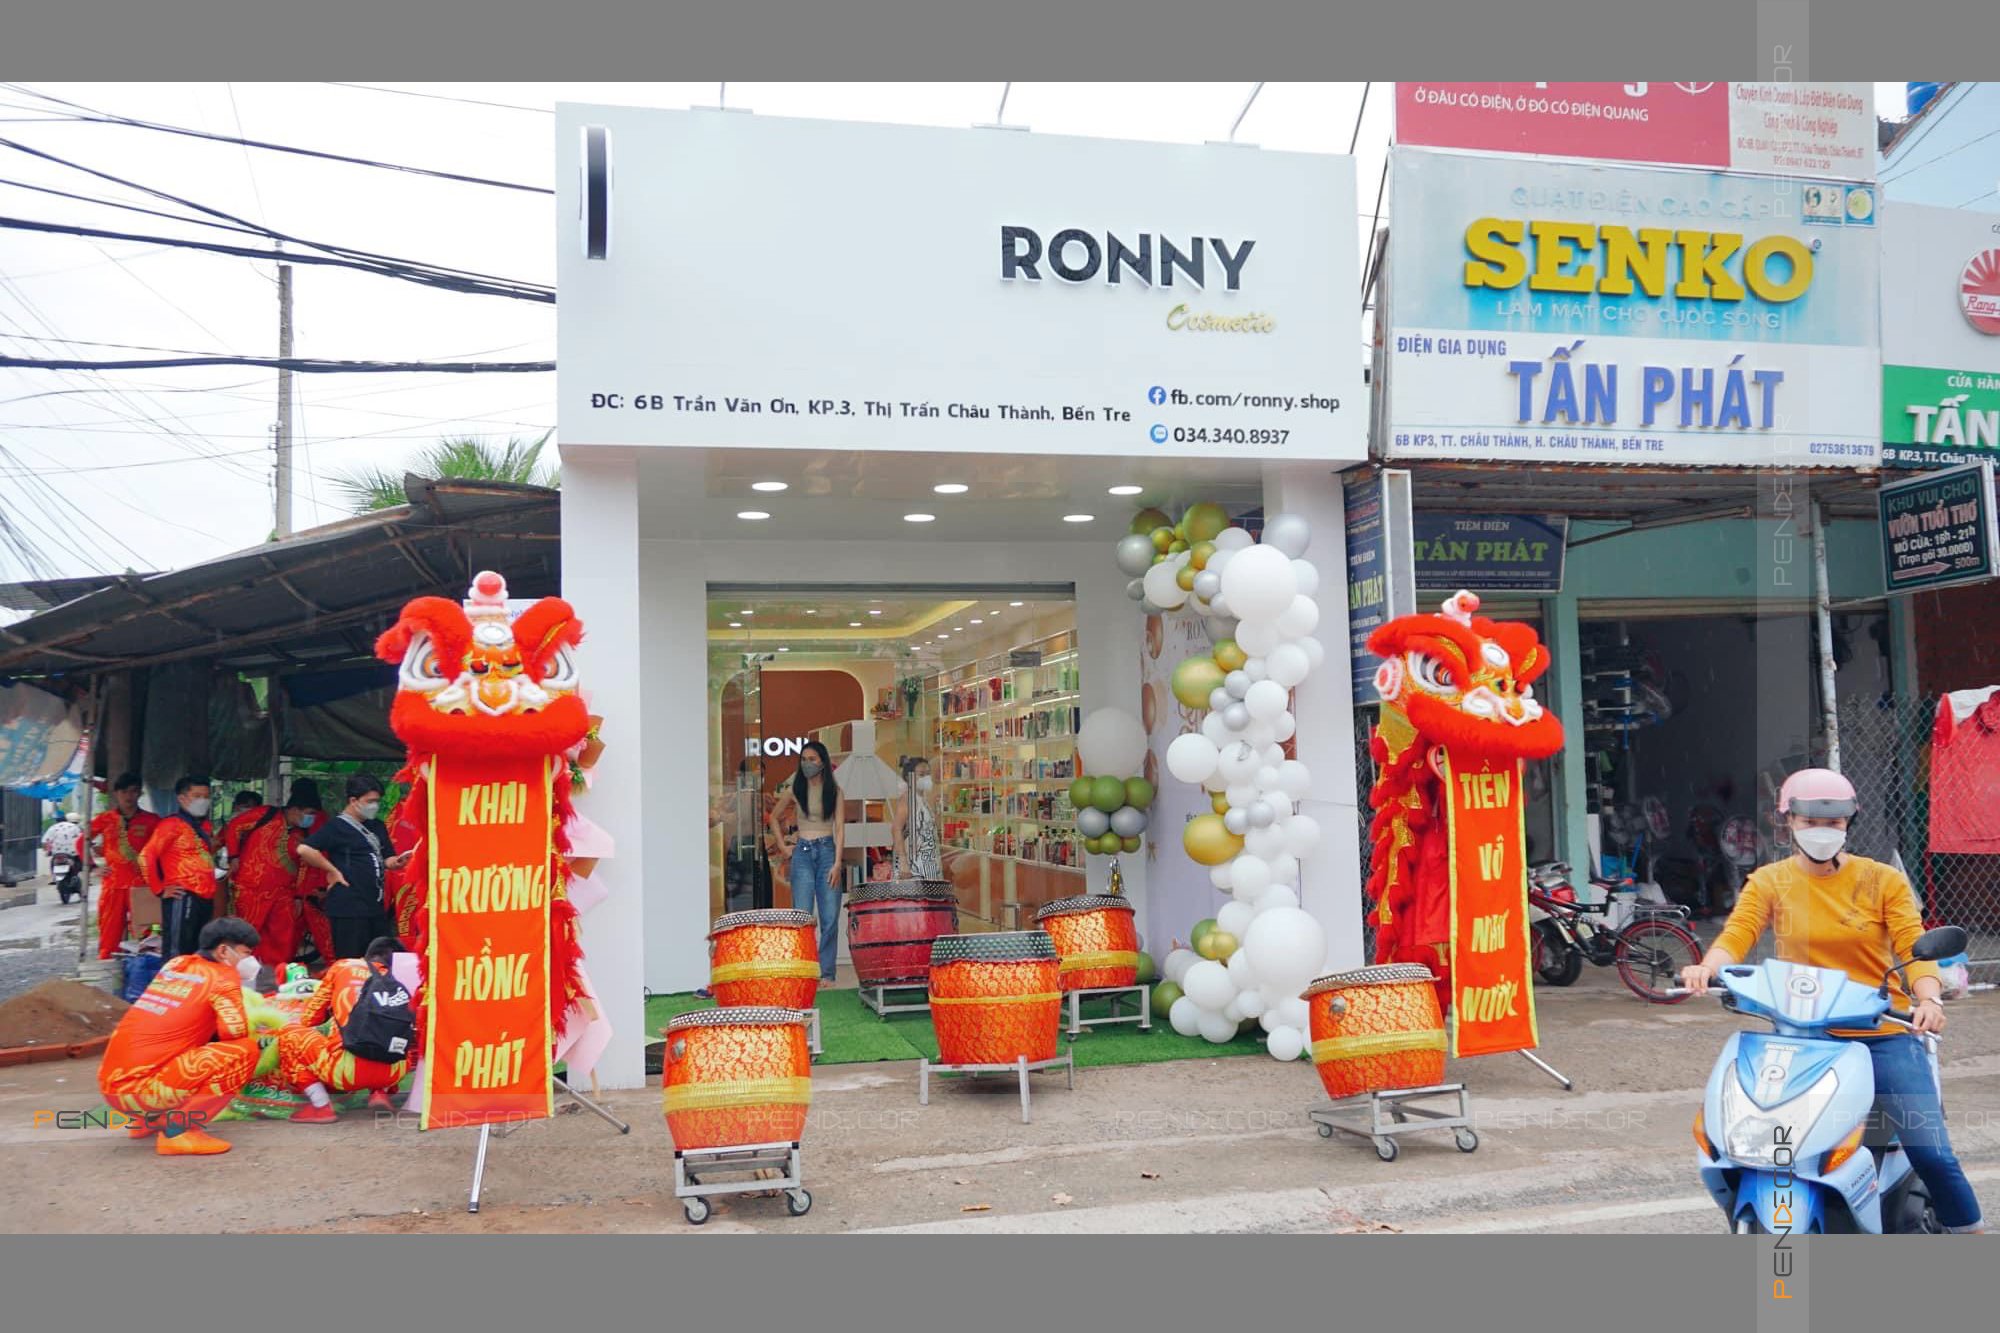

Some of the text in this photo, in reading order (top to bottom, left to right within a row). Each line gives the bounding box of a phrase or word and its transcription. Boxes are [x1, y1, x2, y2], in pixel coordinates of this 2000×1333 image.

[1428, 90, 1457, 106] ĐÂU
[1460, 91, 1481, 107] CÓ
[1529, 97, 1549, 113] ĐÓ
[1551, 98, 1570, 115] CÓ
[1572, 100, 1601, 120] ĐIỆN
[1603, 105, 1649, 122] QUANG
[1001, 225, 1257, 291] RONNY
[1464, 217, 1814, 303] SENKO
[1397, 333, 1508, 360] ĐIỆN GIA DỤNG
[1170, 388, 1341, 413] fb.com/ronny.shop
[1508, 340, 1785, 429] TẤN PHÁT
[1947, 371, 1974, 389] CỬA
[591, 393, 625, 410] ĐC:
[724, 397, 762, 414] Văn
[864, 401, 892, 418] Thị
[947, 403, 990, 420] Châu
[1062, 406, 1095, 422] Bến
[1103, 407, 1132, 422] Tre
[1906, 393, 2000, 448] TẤN
[1173, 427, 1290, 445] 034.340.8937
[1440, 435, 1457, 448] TT.
[1460, 434, 1491, 448] CHÂU
[1549, 435, 1579, 449] CHÂU
[1621, 436, 1643, 451] BẾN
[1645, 438, 1665, 451] TRE
[1888, 494, 1914, 514] KHU
[1917, 486, 1939, 507] VUI
[1414, 533, 1549, 562] TẤN PHÁT
[1955, 556, 1980, 570] 500m
[1349, 571, 1362, 611] ẤN
[458, 780, 528, 826] KHAI
[1459, 758, 1511, 810] TIỀN
[1478, 833, 1505, 881] VÔ
[438, 861, 545, 915] TRƯƠNG
[1471, 908, 1510, 954] NHƯ
[453, 937, 532, 1002] HỒNG
[1462, 974, 1519, 1024] NƯỚC
[453, 1031, 527, 1089] PHÁT
